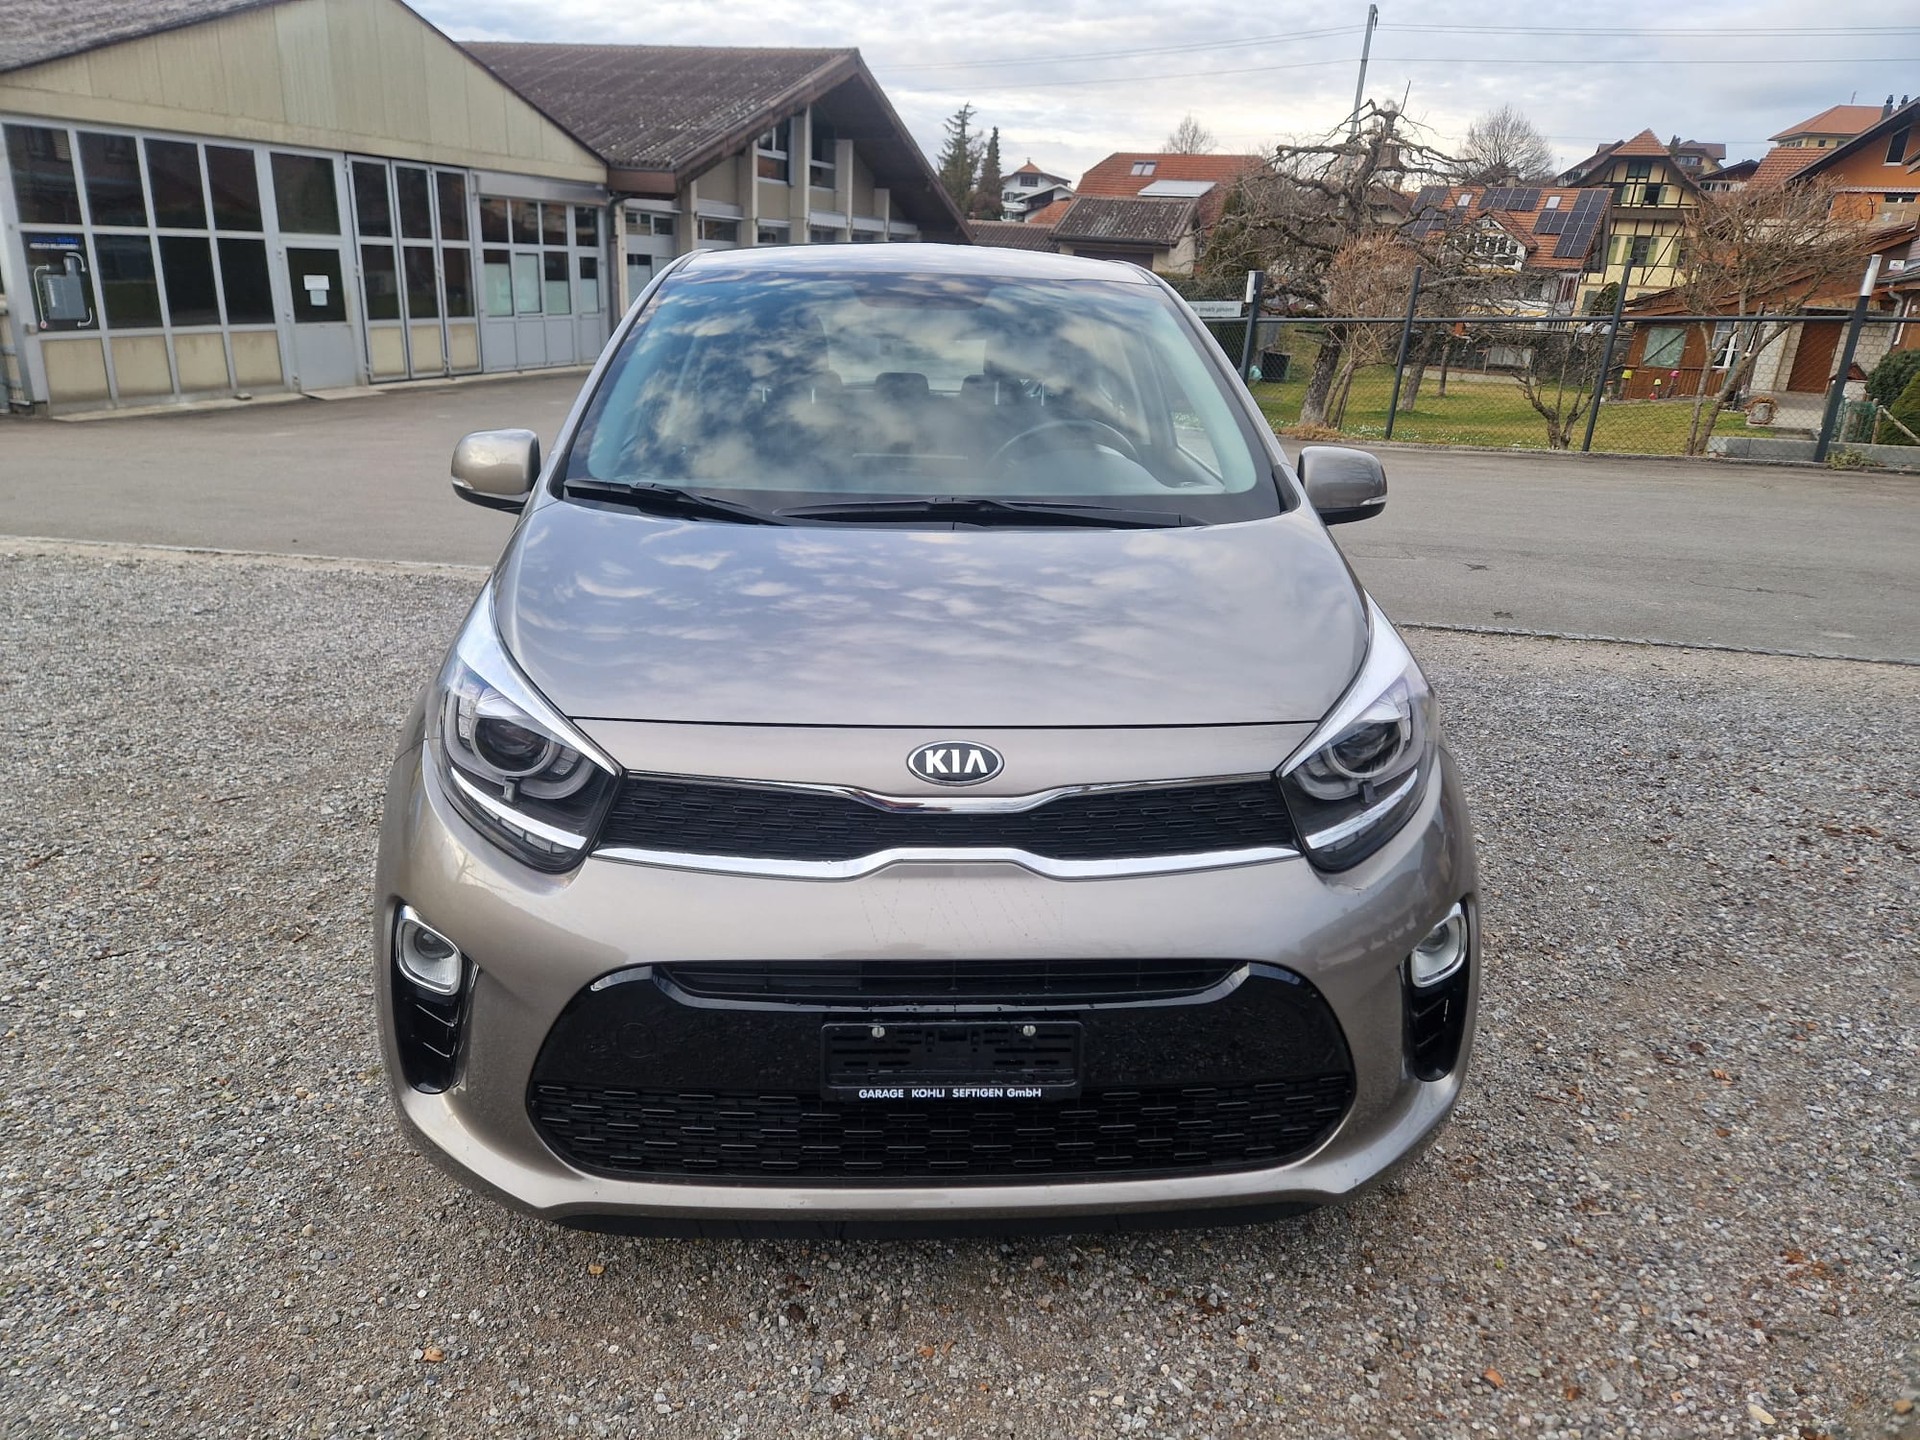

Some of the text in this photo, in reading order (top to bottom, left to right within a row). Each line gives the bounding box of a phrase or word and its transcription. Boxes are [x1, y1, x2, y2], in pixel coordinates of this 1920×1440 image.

[924, 749, 989, 774] KIA
[859, 1087, 1042, 1099] GARAGE KOHLI SEFTIGEN GmbH
